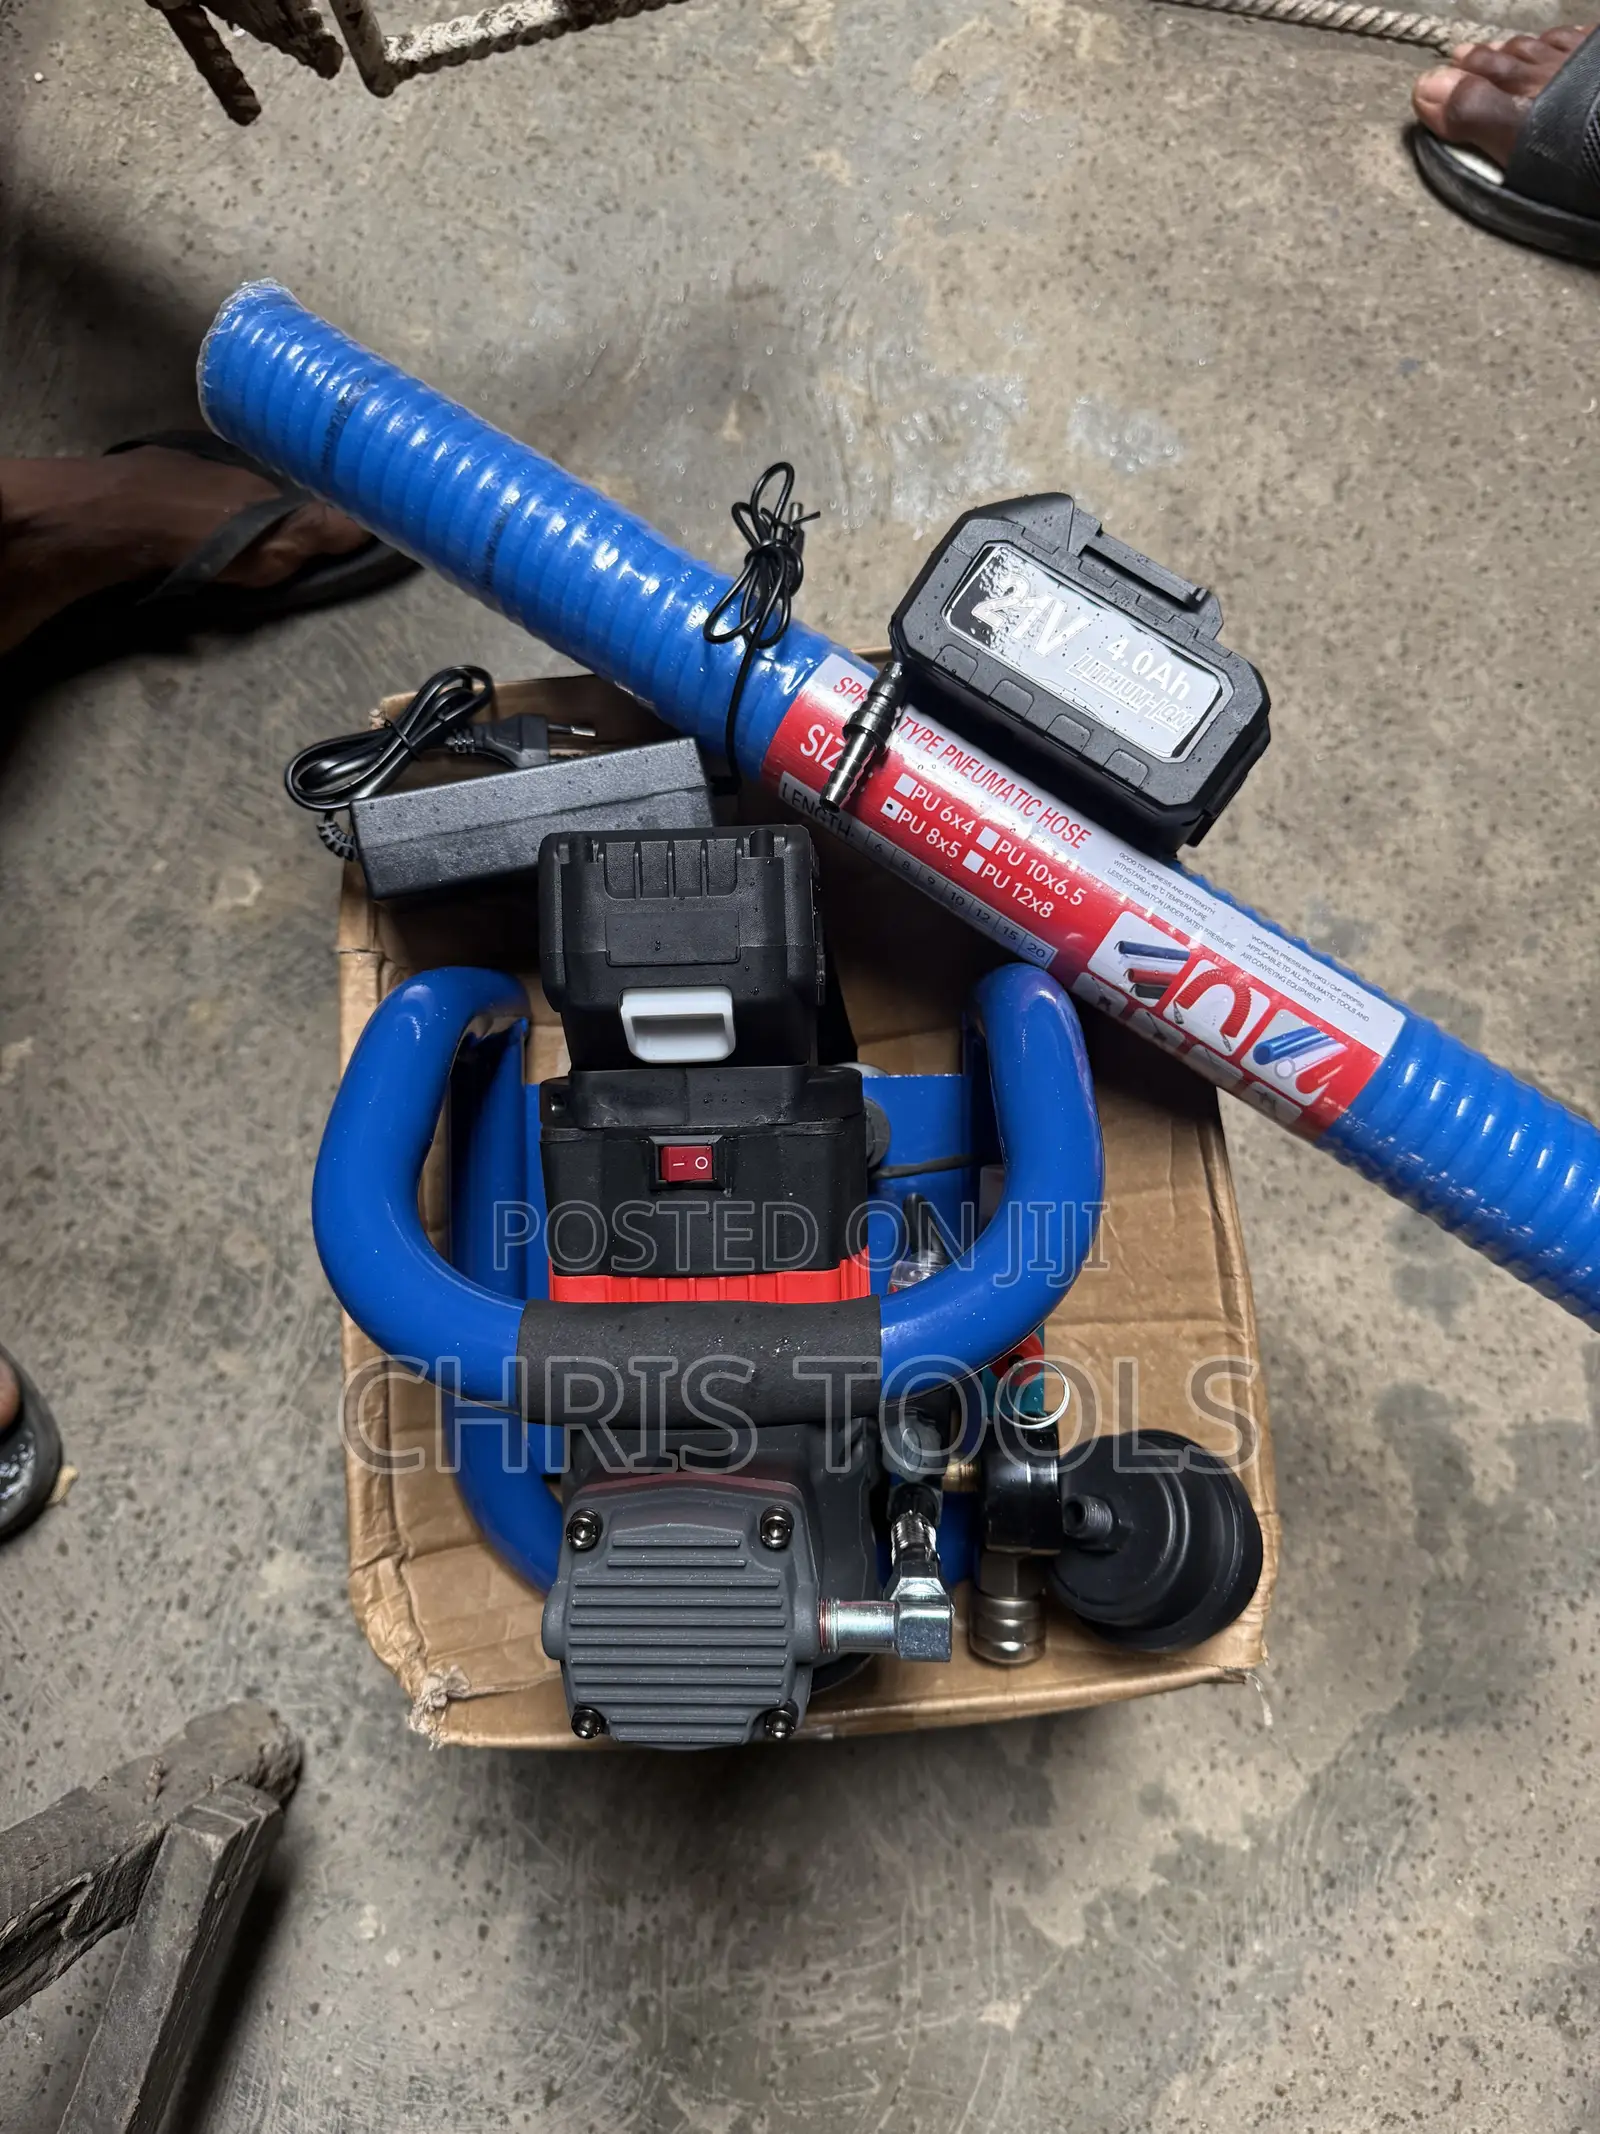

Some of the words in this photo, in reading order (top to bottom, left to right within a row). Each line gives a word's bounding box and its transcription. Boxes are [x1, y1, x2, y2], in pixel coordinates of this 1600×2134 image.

[971, 573, 1091, 656] 21V
[1106, 637, 1191, 700] 4.0Ah
[898, 716, 943, 754] TYPE
[937, 744, 1039, 817] PNEUMATIC
[1035, 806, 1093, 850] HOSE
[910, 784, 942, 814] PU
[938, 803, 977, 836] 6x4
[896, 808, 927, 836] PU
[924, 826, 963, 859] 8x5
[874, 842, 884, 853] 6
[901, 860, 911, 871] 8
[926, 876, 936, 885] 9
[949, 892, 966, 907] 10
[974, 908, 991, 923] 12
[1002, 926, 1019, 941] 15
[1027, 942, 1047, 959] 20
[980, 863, 1011, 890] PU
[1008, 881, 1056, 920] 12x8
[994, 839, 1027, 868] PU
[1023, 858, 1088, 907] 10x6.5
[1107, 868, 1124, 881] LESS
[1122, 877, 1164, 906] DEFORMATION
[1163, 903, 1185, 919] UNDER
[1113, 860, 1147, 884] WITHSTAND
[1165, 892, 1207, 921] TEMPERATURE
[1240, 951, 1252, 962] AIR
[1251, 958, 1287, 983] CONVEYING
[1285, 979, 1321, 1004] EQUIPMENT
[1246, 943, 1282, 968] APPLICABLE
[1290, 970, 1303, 981] ALL
[1301, 977, 1337, 1002] PNEUMATIC
[1335, 998, 1357, 1014] TOOLS
[1355, 1011, 1370, 1022] AND
